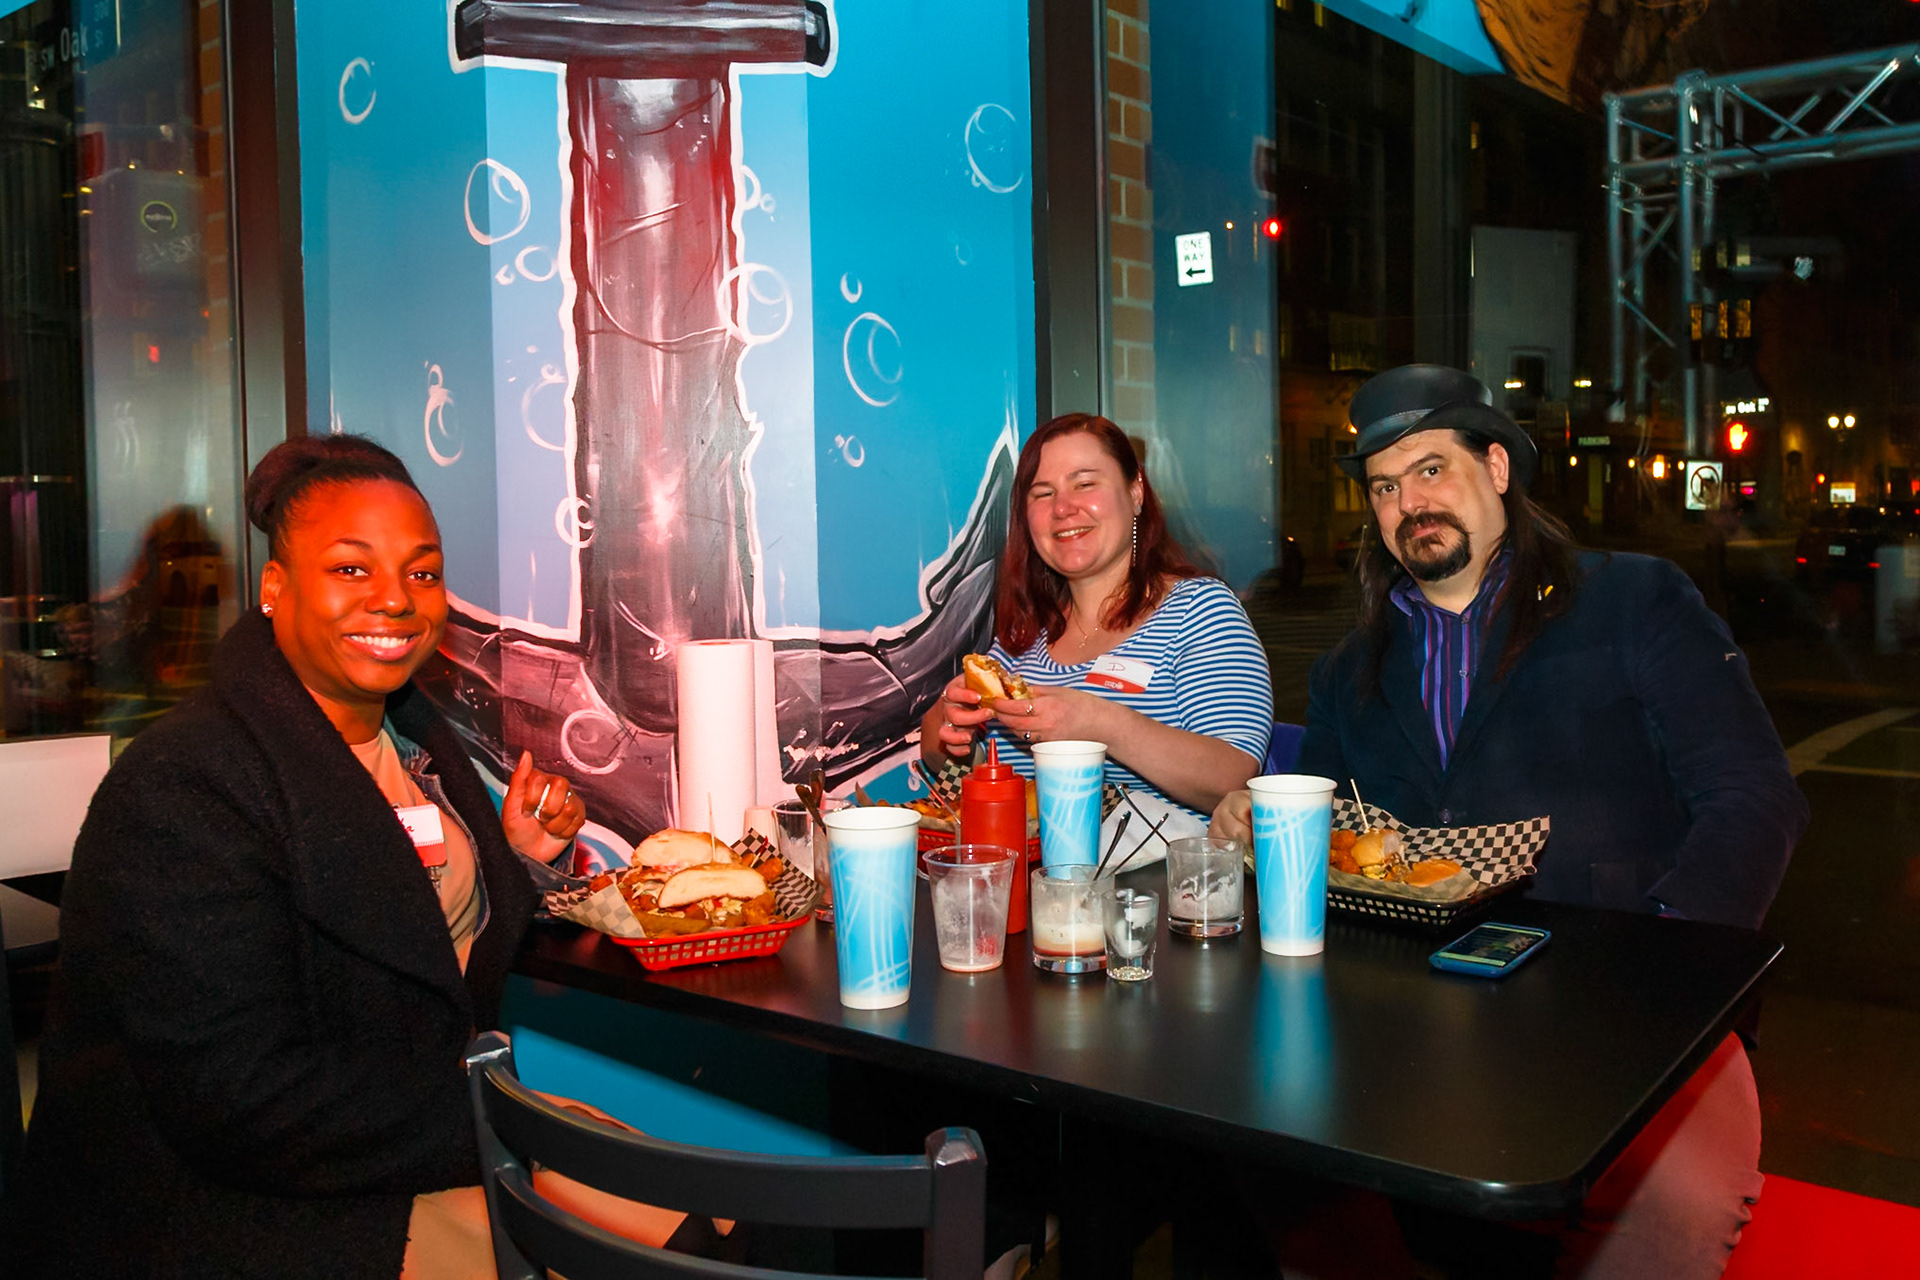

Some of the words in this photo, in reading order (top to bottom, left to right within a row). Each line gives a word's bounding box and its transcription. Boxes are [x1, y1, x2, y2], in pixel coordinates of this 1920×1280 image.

[60, 24, 89, 62] Oak
[1183, 237, 1204, 250] ONE
[1184, 252, 1205, 262] WAY
